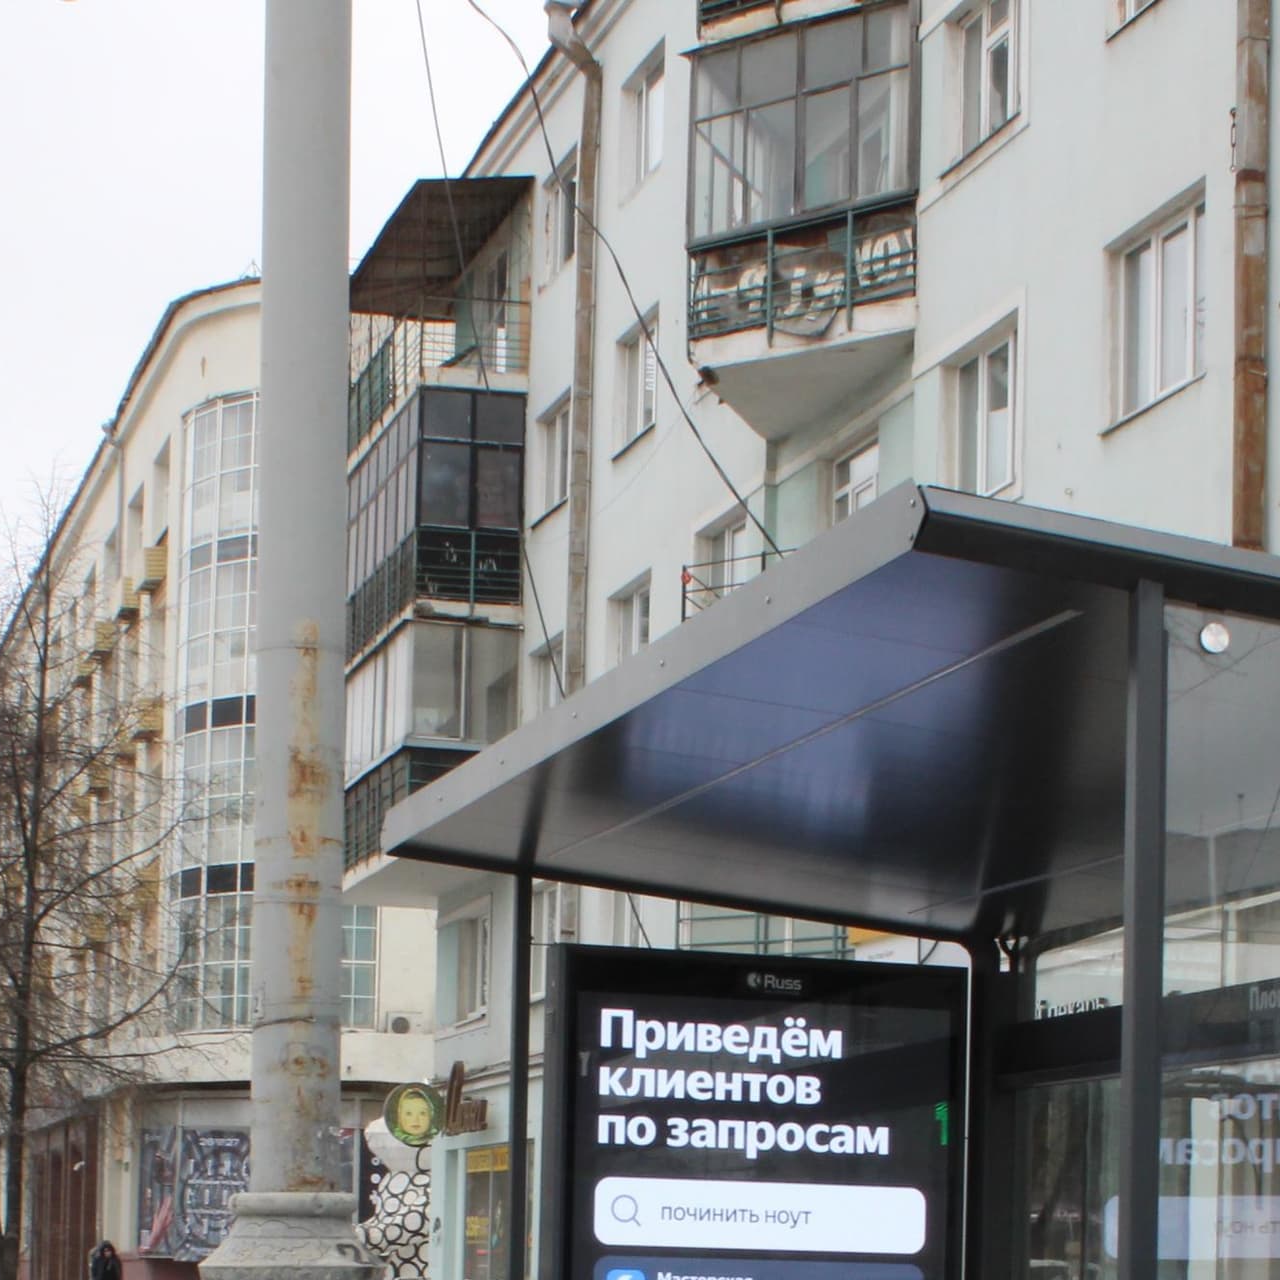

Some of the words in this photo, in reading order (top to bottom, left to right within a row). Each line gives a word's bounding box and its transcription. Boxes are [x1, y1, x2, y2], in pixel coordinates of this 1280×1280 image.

[764, 973, 803, 991] Russ
[600, 1008, 843, 1064] Приведём
[598, 1066, 822, 1105] клиентов
[597, 1114, 657, 1146] по
[666, 1117, 890, 1160] запросам
[661, 1205, 760, 1224] починить
[764, 1209, 812, 1229] ноут
